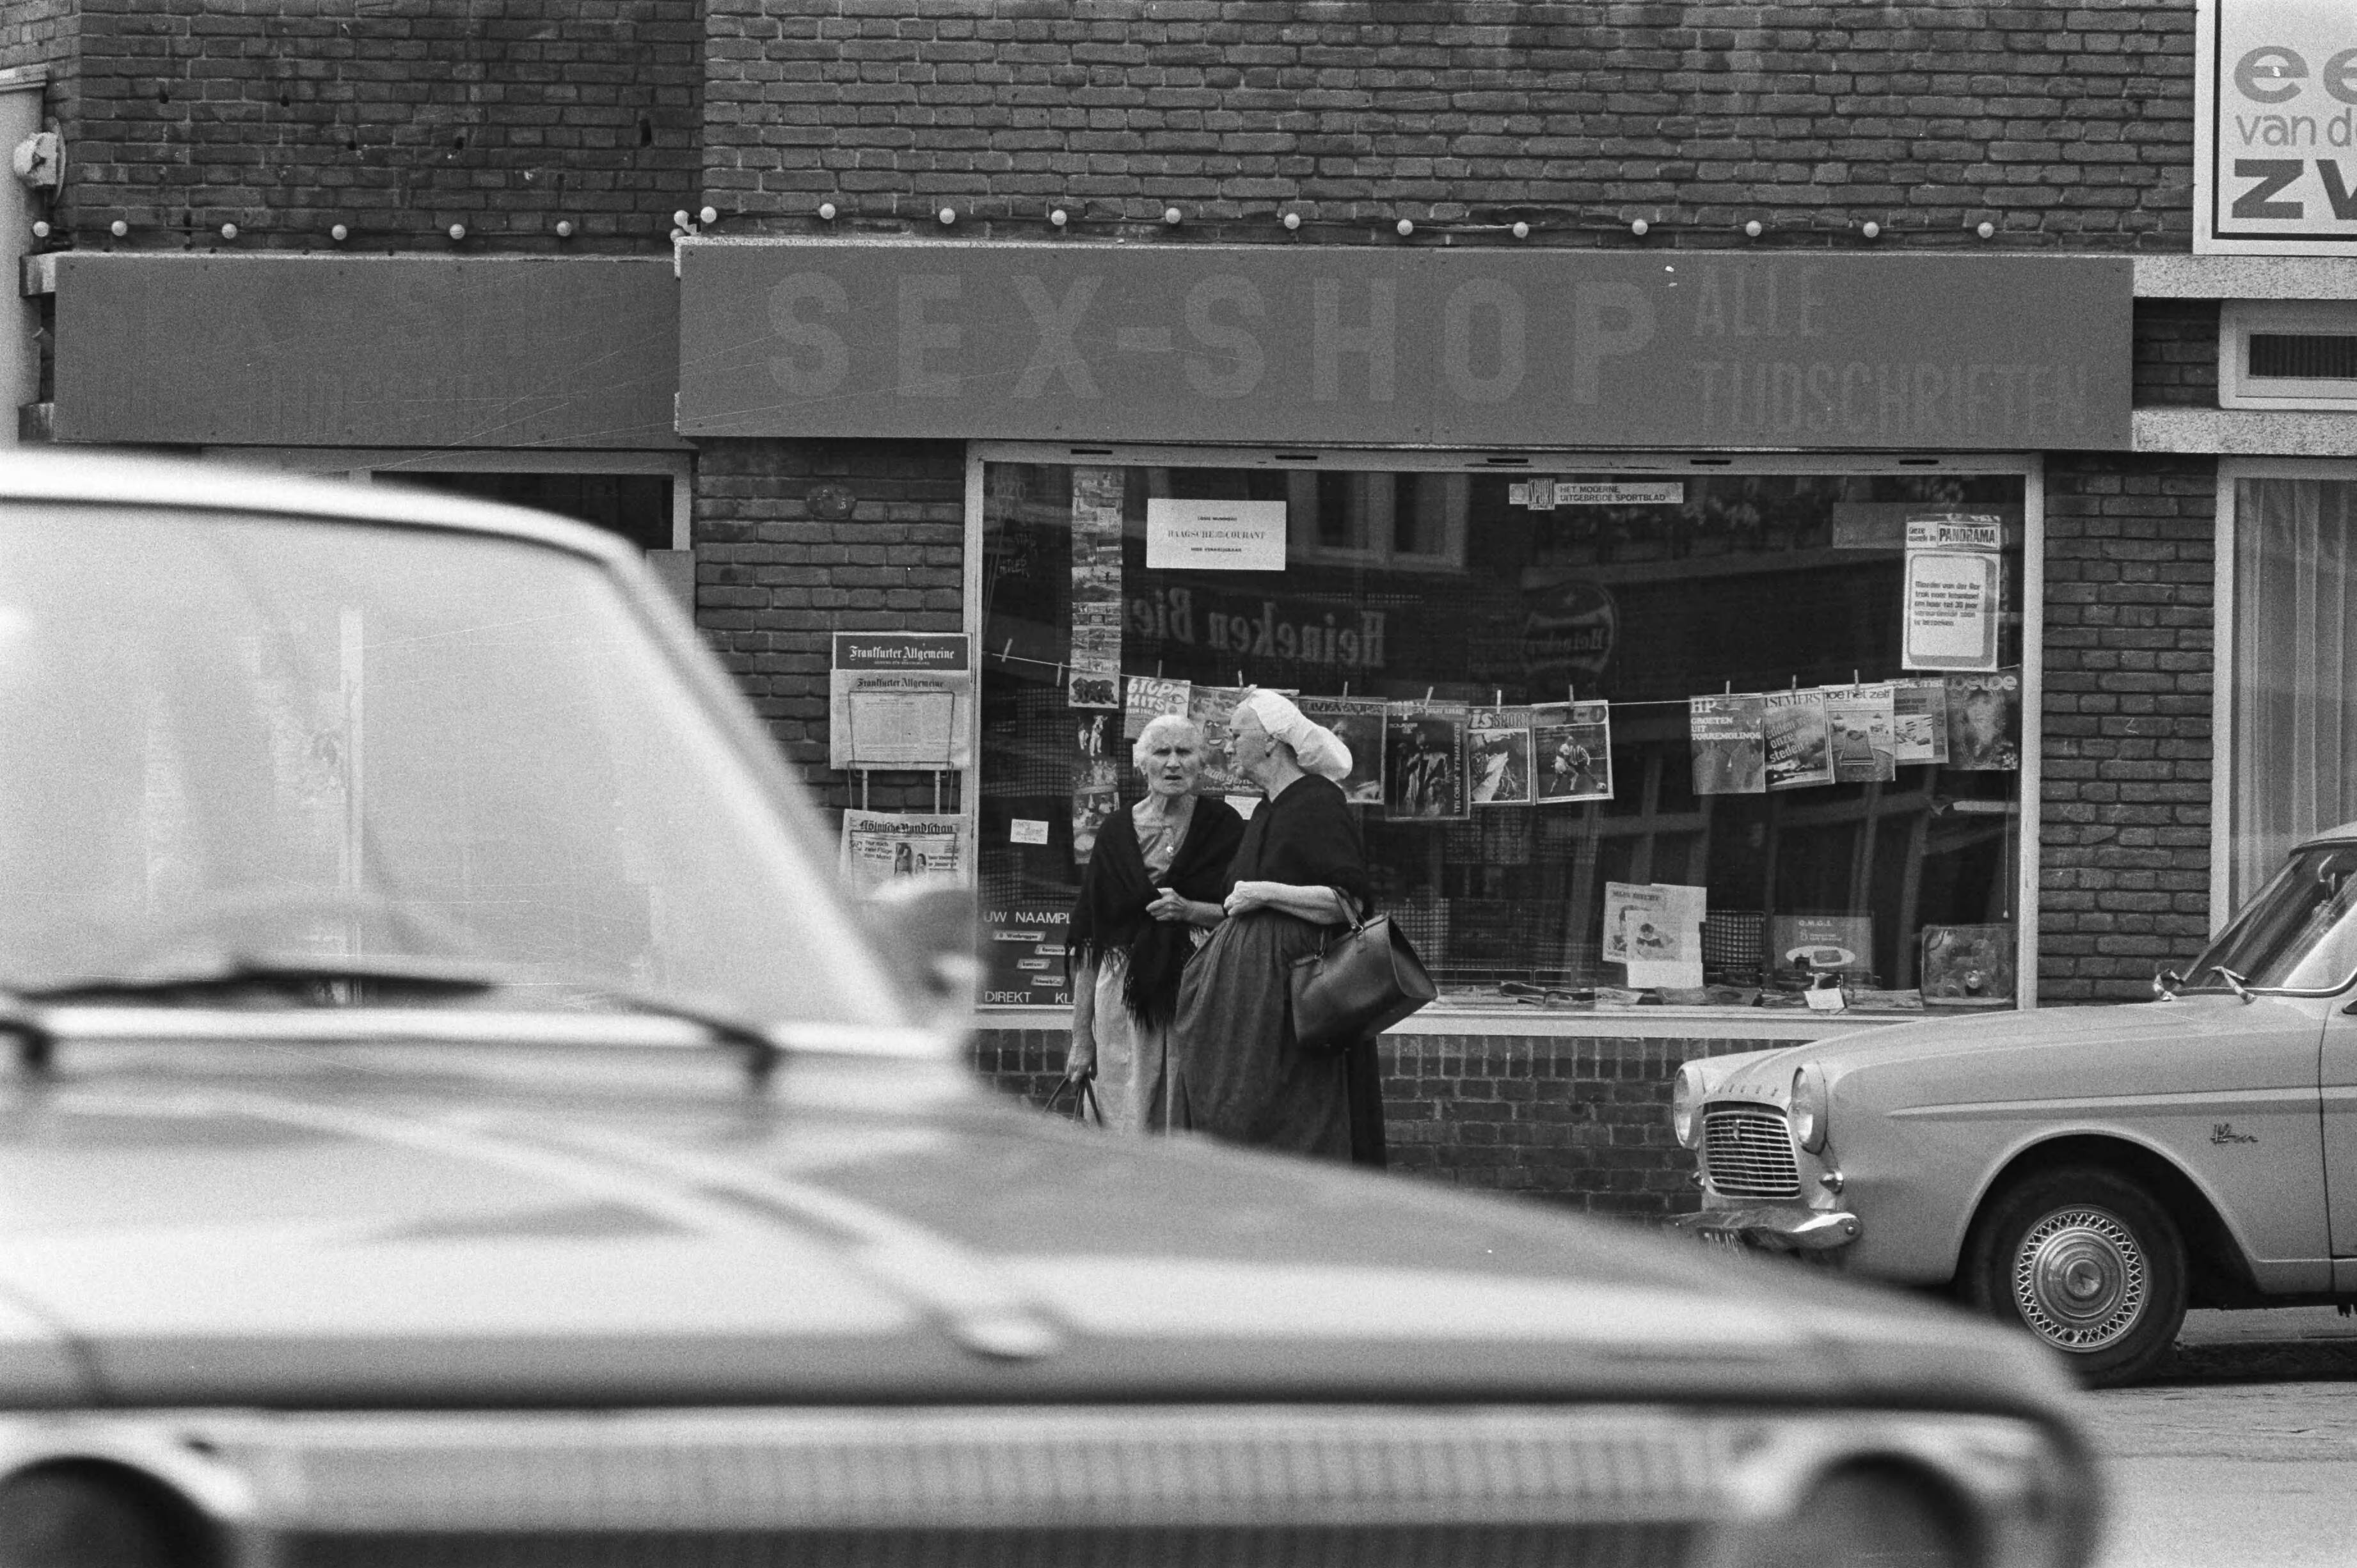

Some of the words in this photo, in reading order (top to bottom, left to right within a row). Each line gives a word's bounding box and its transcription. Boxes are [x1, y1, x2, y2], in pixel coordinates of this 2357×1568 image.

[2235, 115, 2316, 146] van
[2326, 107, 2357, 147] d
[1693, 264, 1826, 337] ALLE
[768, 271, 1656, 405] SEX-SHOP
[1225, 530, 1265, 539] COURANT
[1939, 528, 1996, 543] PANORAMA
[849, 645, 903, 661] Frankfurter
[903, 645, 955, 661] Allgemeine
[857, 677, 900, 688] Frankfurter
[901, 677, 944, 688] Allgemeine
[1869, 689, 1891, 699] zelf
[1127, 694, 1164, 711] HITS
[1690, 698, 1717, 713] HP
[1770, 733, 1795, 749] onze
[1769, 743, 1805, 763] steden
[983, 911, 1007, 922] UW
[985, 991, 1031, 1002] DIREKT
[1056, 992, 1075, 1004] KL
